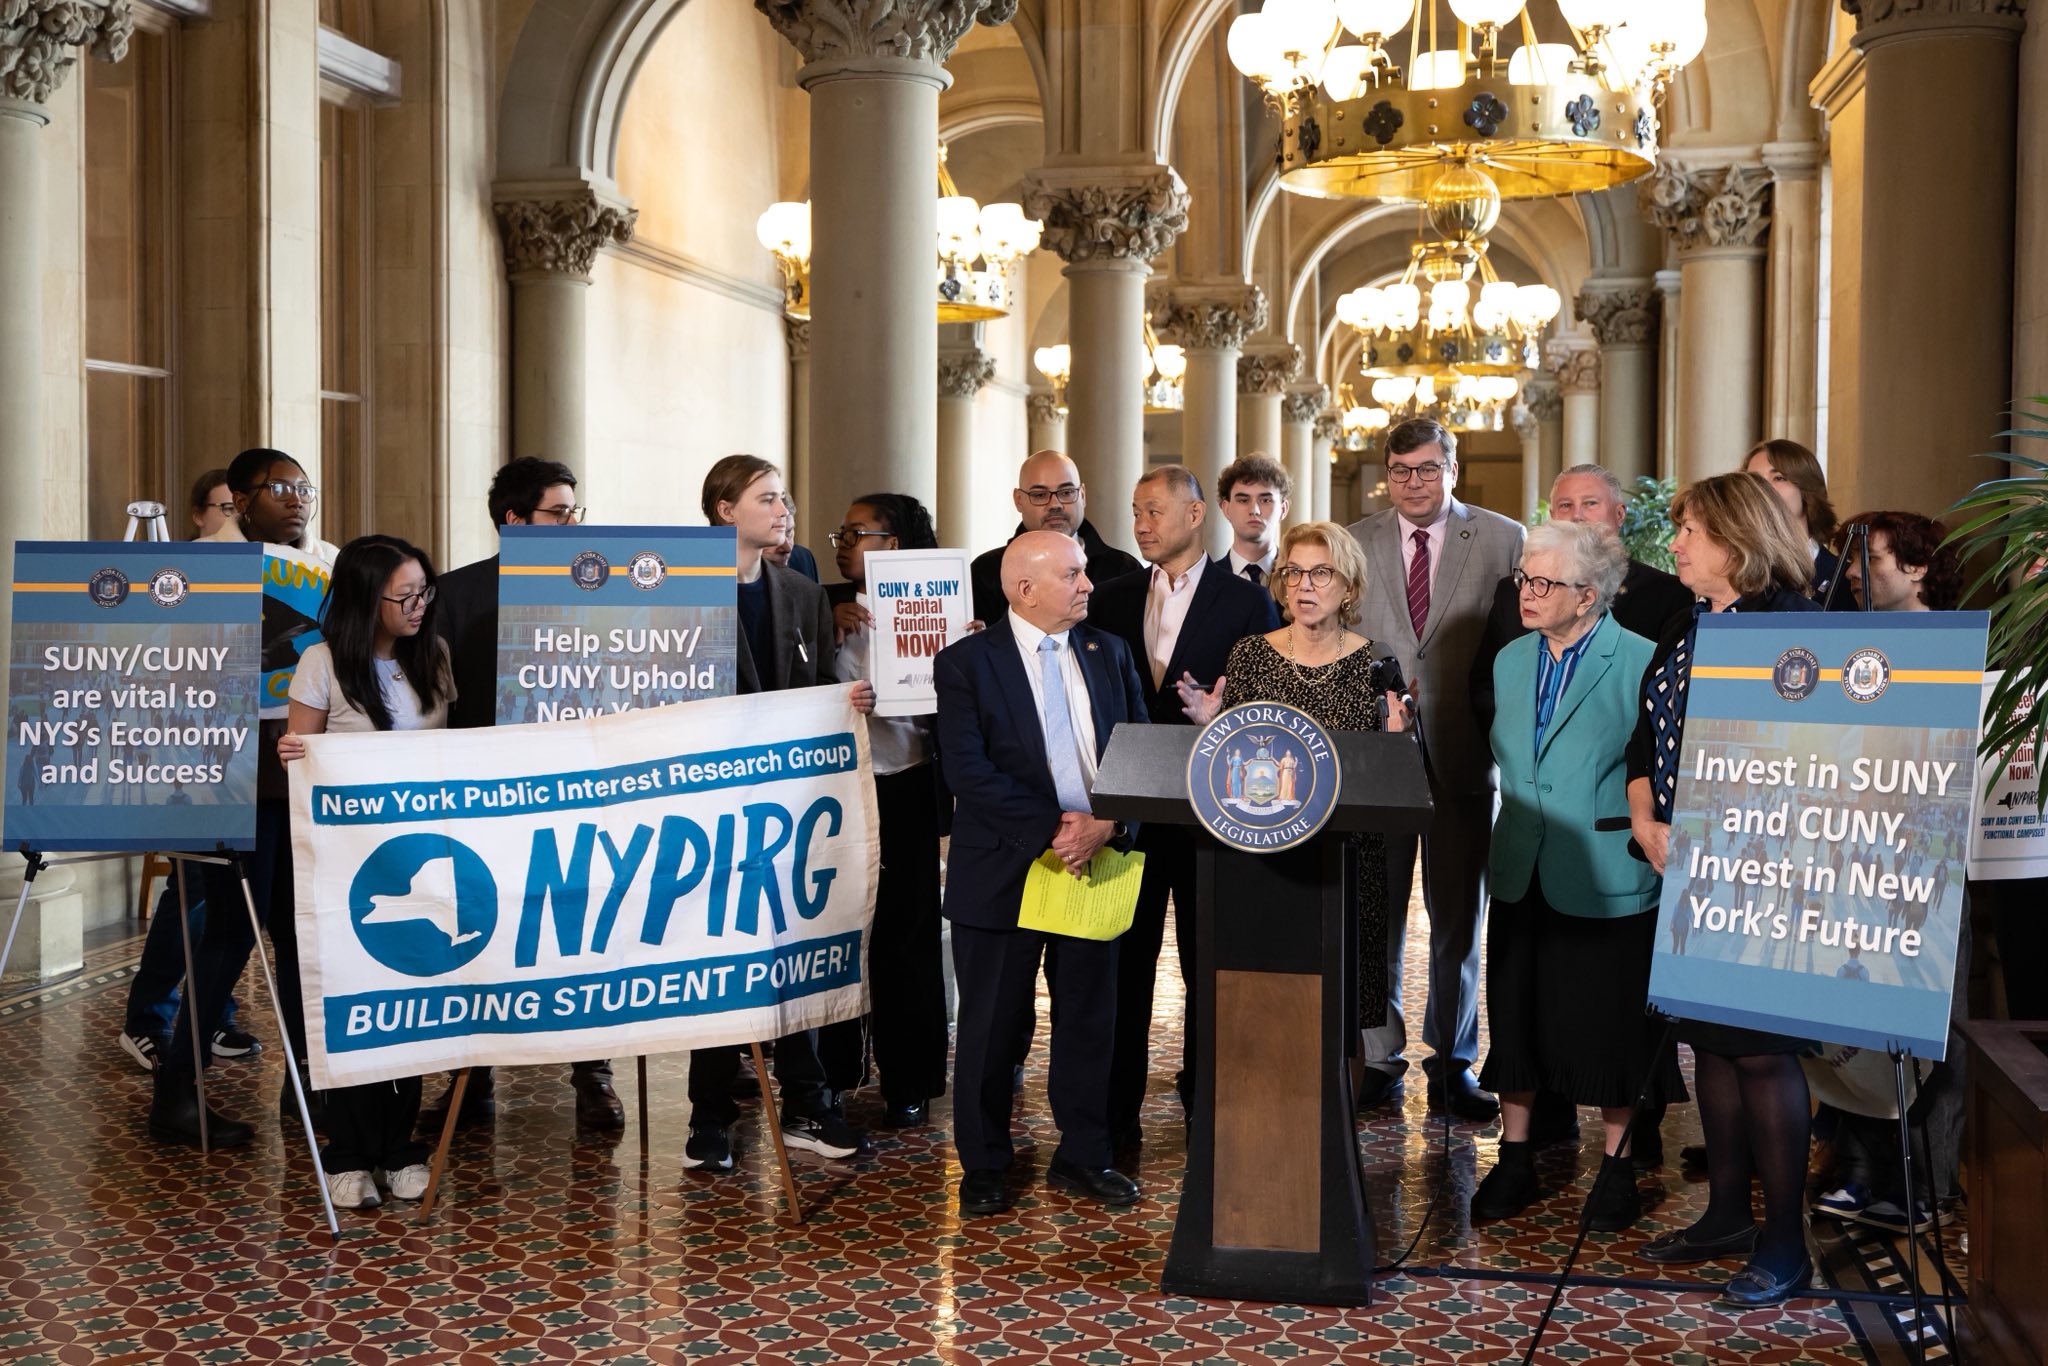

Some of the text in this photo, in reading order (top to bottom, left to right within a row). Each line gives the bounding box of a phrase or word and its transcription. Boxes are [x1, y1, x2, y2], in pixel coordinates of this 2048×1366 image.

[878, 580, 959, 598] CUNY & SUNY
[896, 598, 943, 616] Capital
[893, 616, 947, 632] Funding
[534, 626, 702, 658] Help SUNY/
[896, 633, 946, 658] NOW!
[44, 644, 229, 676] SUNY/CUNY
[518, 664, 715, 695] CUNY Uphold
[53, 683, 216, 709] are vital to
[537, 702, 603, 723] New
[19, 721, 248, 751] NYS's Economy
[1199, 707, 1330, 762] NEW YORK STATE
[41, 758, 223, 784] and Success
[321, 744, 850, 816] New York Public Interest Research Group
[1694, 749, 1957, 797] Invest in SUNY
[2009, 764, 2034, 781] Now!
[1212, 815, 1311, 845] LEGISLATURE
[1723, 802, 1907, 853] and CUNY,
[514, 796, 843, 968] NYPIRG
[1689, 847, 1936, 904] Invest in New
[1689, 896, 1922, 957] York's Future
[346, 943, 851, 1036] BUILDING STUDENT POWER!
